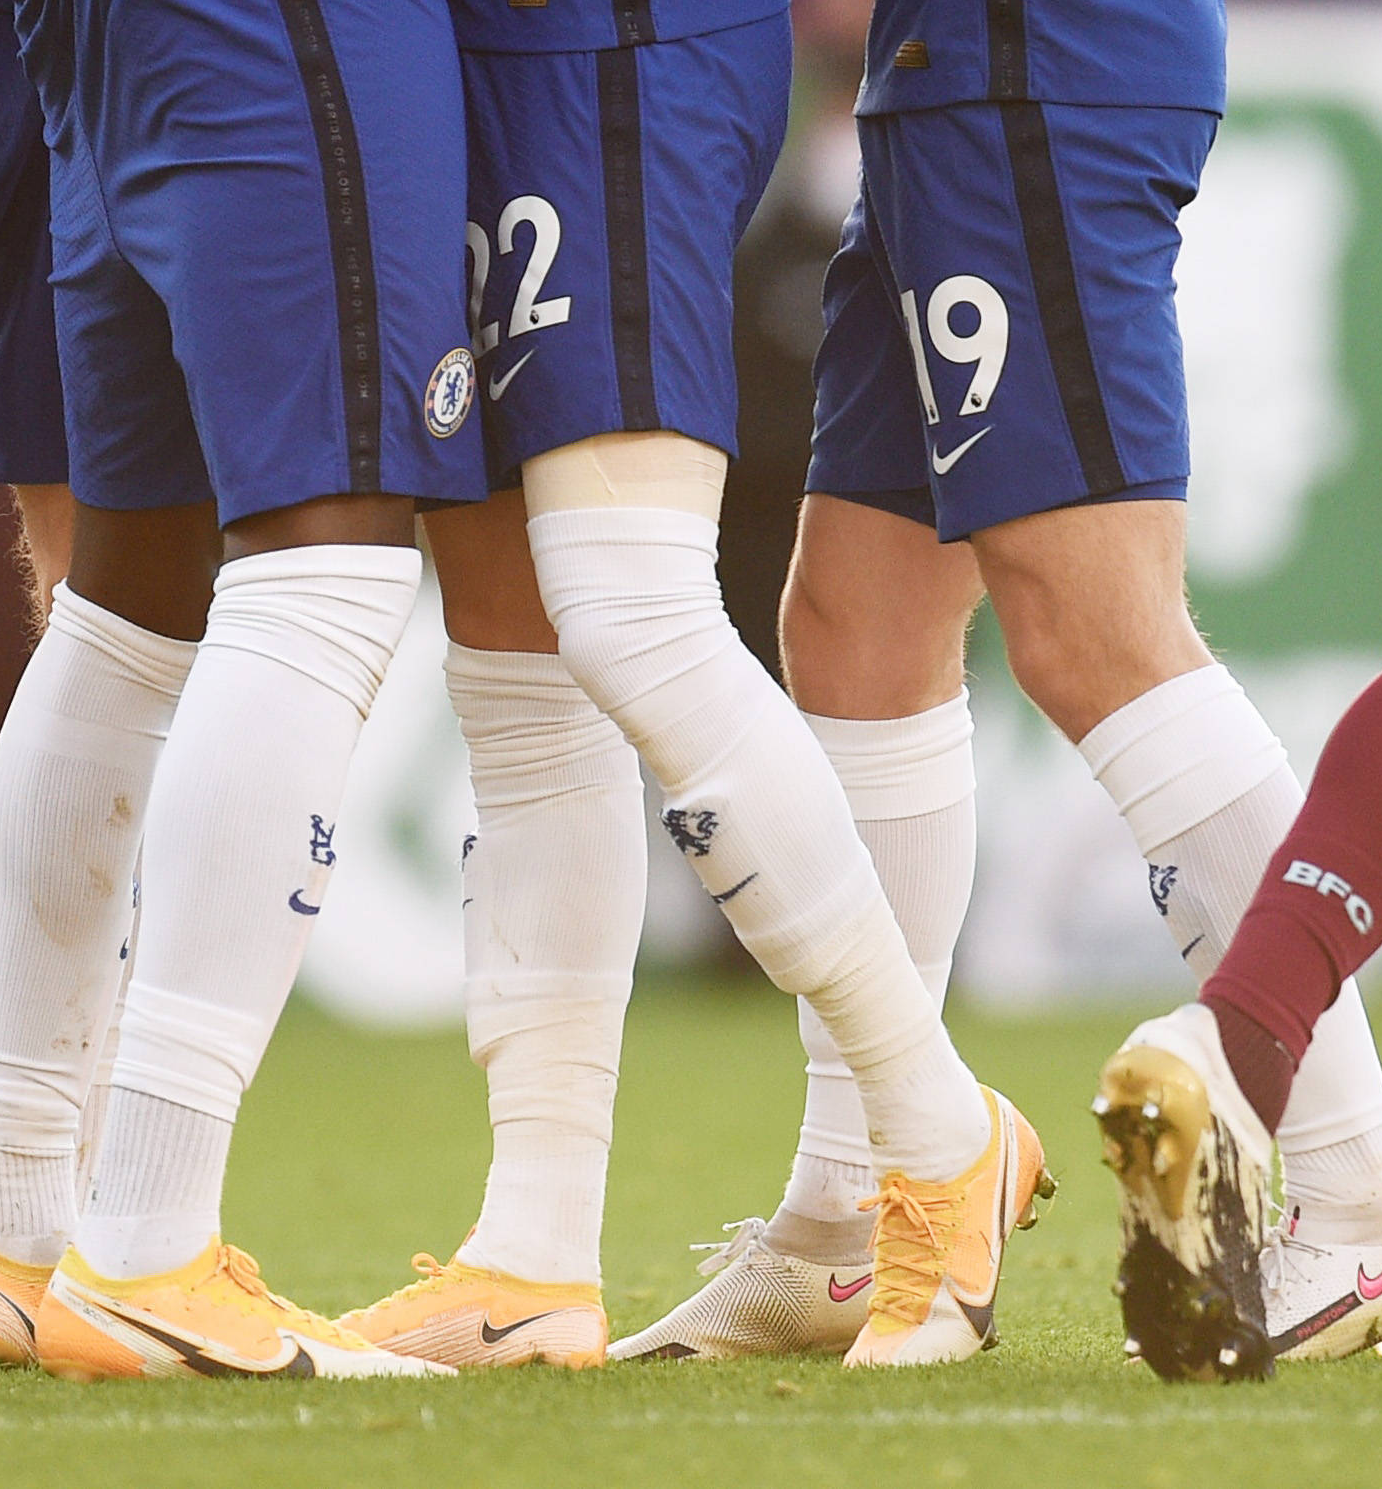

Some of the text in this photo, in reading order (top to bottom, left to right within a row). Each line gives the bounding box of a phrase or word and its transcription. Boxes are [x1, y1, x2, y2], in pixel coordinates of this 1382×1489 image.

[464, 193, 572, 359] 22
[899, 273, 1011, 427] 19
[1282, 860, 1374, 936] BFC
